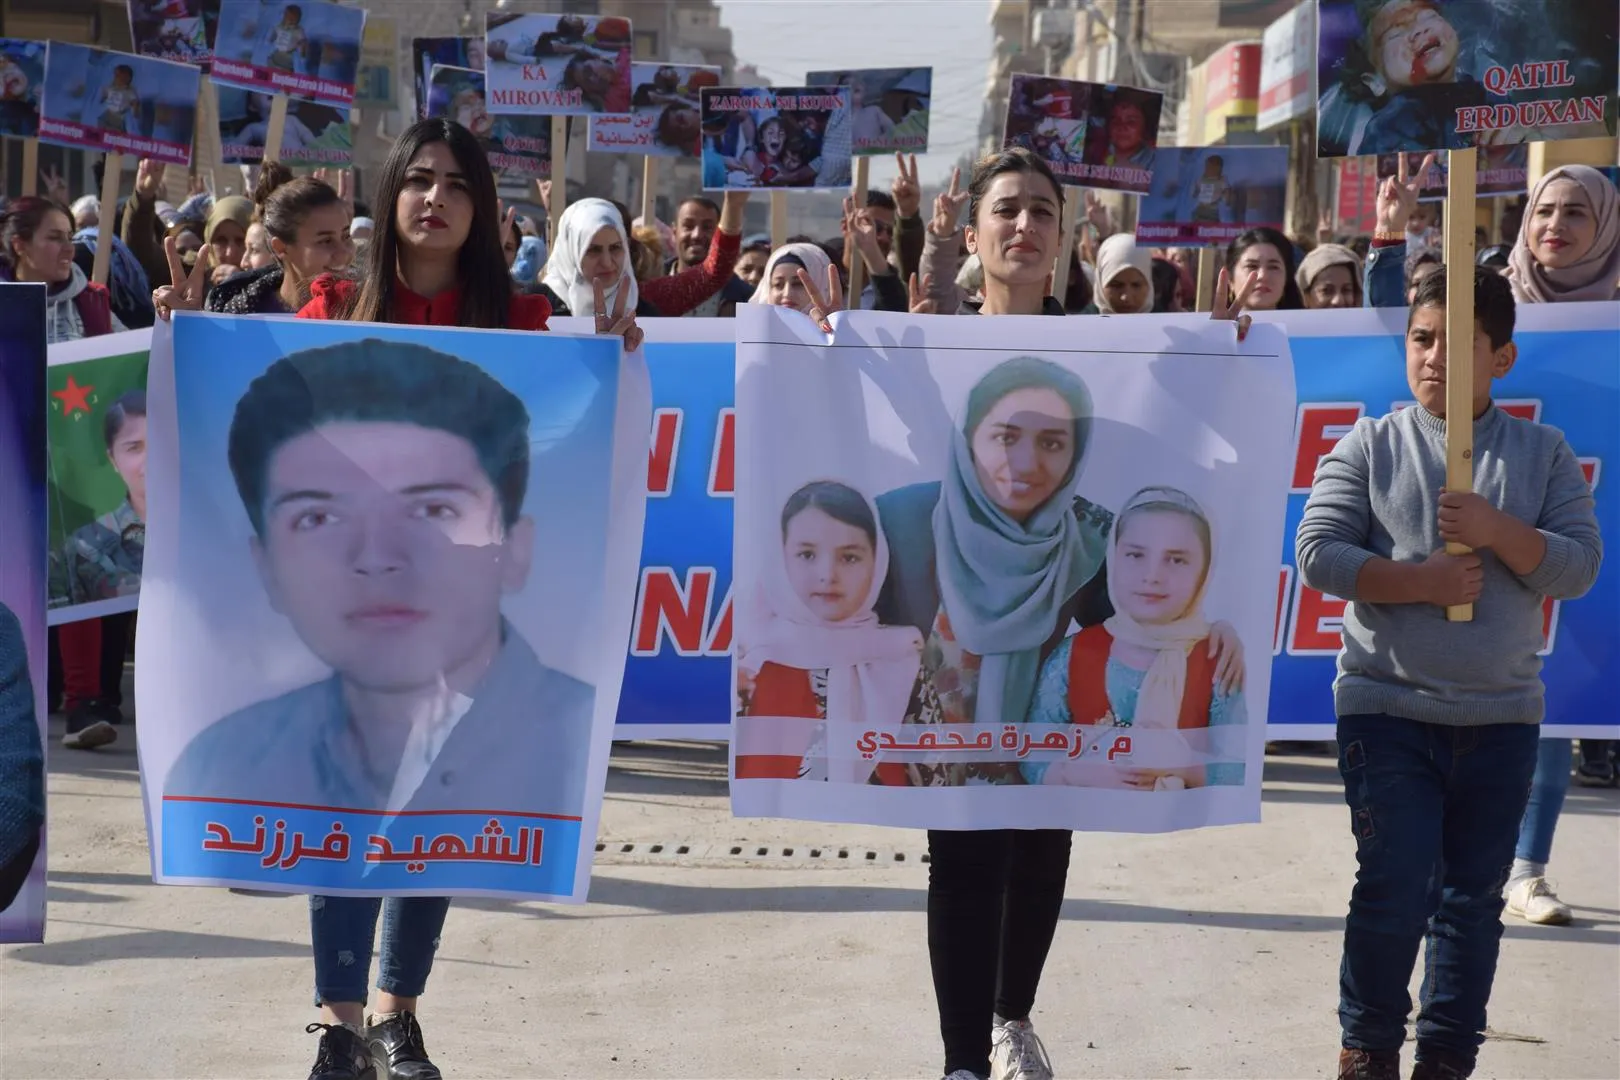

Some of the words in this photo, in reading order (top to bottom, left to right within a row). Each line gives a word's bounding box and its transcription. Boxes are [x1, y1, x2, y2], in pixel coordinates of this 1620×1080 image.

[522, 63, 548, 81] KA
[1483, 60, 1575, 95] QATIL
[1455, 96, 1607, 133] ERDUXAN
[856, 730, 993, 760] محمدي
[1000, 725, 1083, 757] زهرة
[202, 815, 351, 870] فرزند
[364, 818, 545, 873] الشهيد
